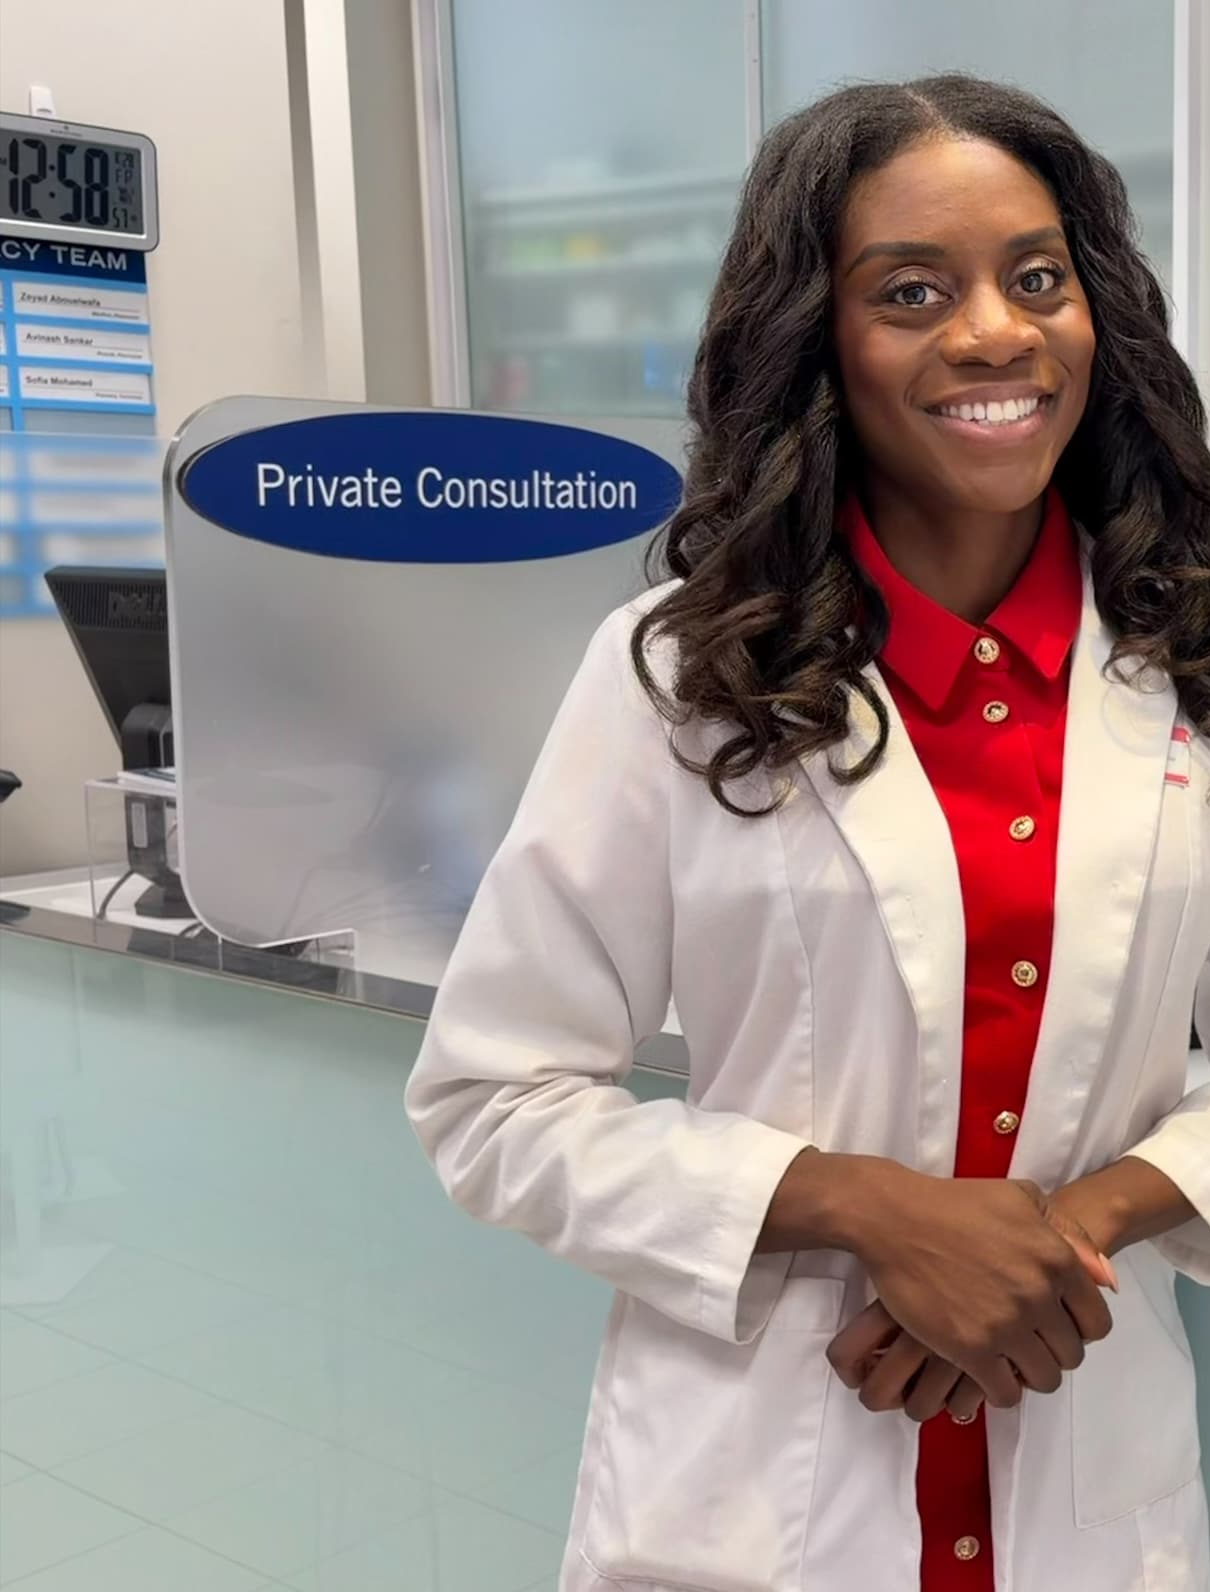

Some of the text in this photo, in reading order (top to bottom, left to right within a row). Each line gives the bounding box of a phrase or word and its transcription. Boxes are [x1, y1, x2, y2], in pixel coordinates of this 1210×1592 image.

[8, 137, 109, 226] 12:58
[0, 240, 127, 271] CY TEAM
[25, 332, 61, 343] Avinash
[25, 376, 93, 387] Sofia Mohamed
[257, 462, 636, 509] Private Consultation
